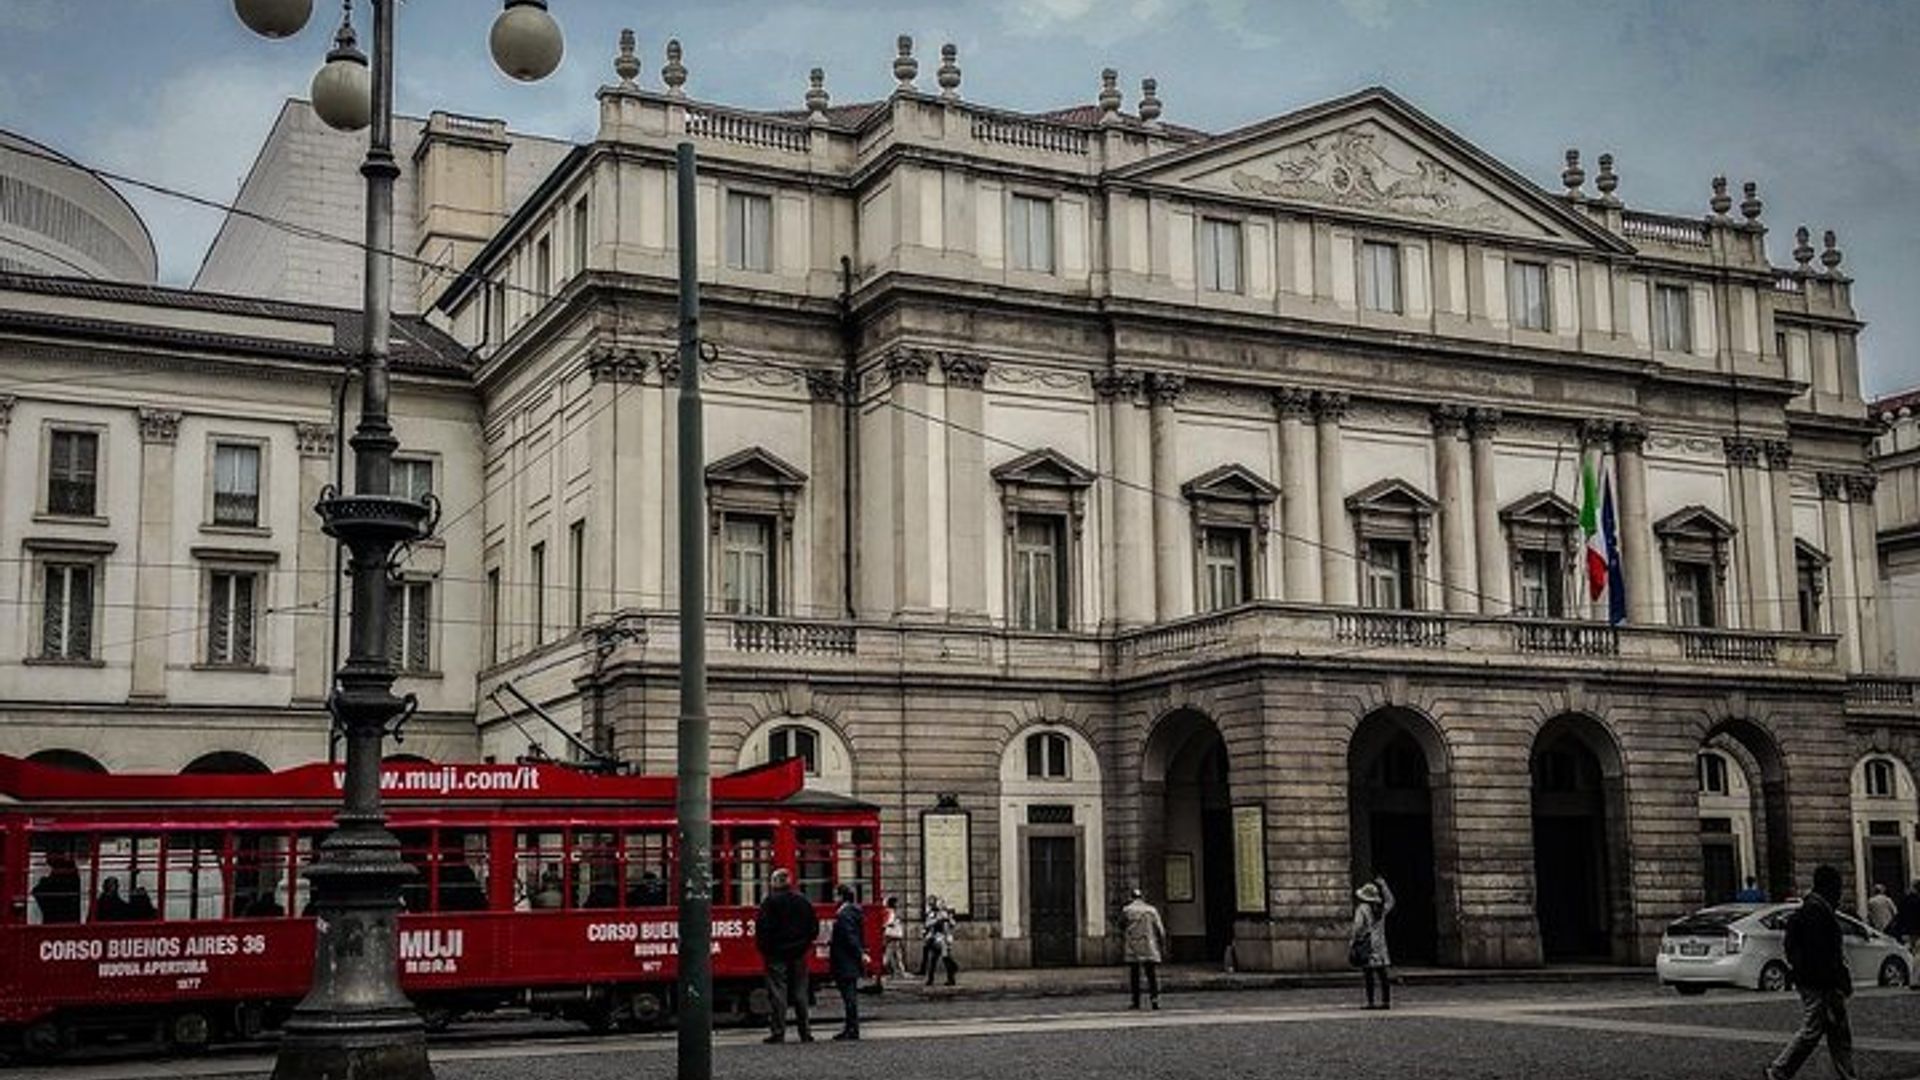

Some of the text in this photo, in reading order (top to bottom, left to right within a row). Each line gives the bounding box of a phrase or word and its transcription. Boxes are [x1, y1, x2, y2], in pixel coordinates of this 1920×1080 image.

[333, 767, 540, 794] ww.muji.com/it
[400, 929, 463, 958] MUJI
[587, 922, 638, 941] CORSO
[640, 921, 679, 940] BUEN
[711, 920, 744, 938] IRES
[40, 934, 265, 961] CORSO BUENOS AIRES 36
